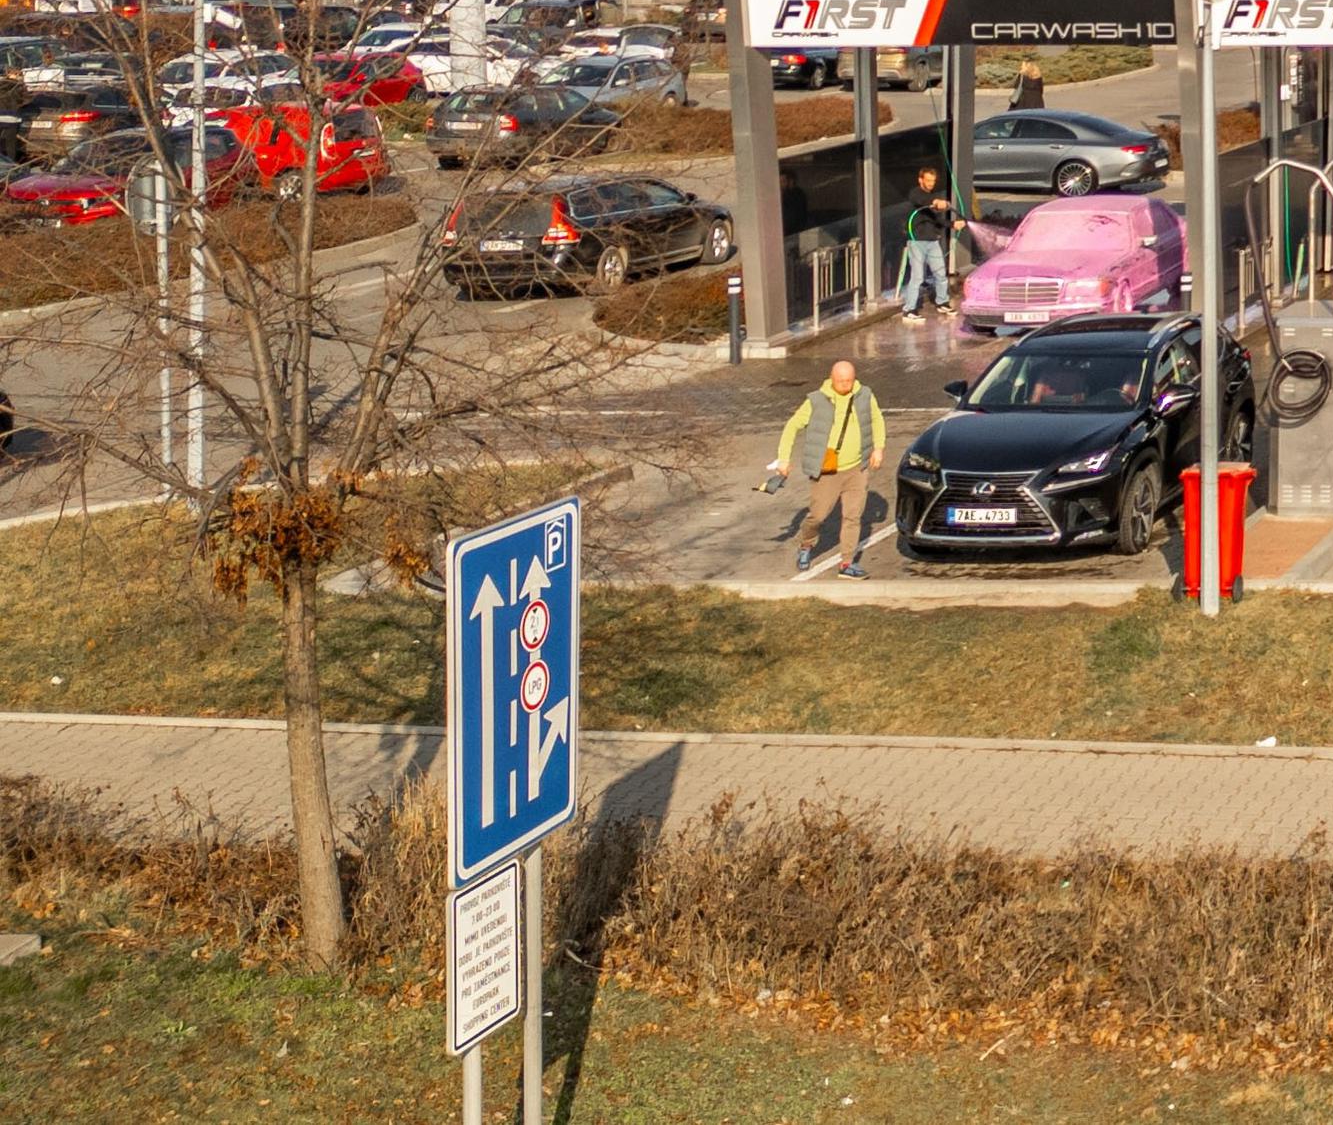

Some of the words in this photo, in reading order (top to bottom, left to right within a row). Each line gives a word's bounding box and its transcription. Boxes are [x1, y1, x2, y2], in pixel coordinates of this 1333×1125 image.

[971, 22, 1142, 39] CARWASH
[1146, 22, 1174, 39] 10
[957, 510, 977, 521] 7AE
[548, 531, 562, 565] P
[528, 677, 542, 694] LPG
[464, 930, 479, 946] MIMO
[461, 985, 472, 1001] PRO
[490, 995, 510, 1018] CENTER
